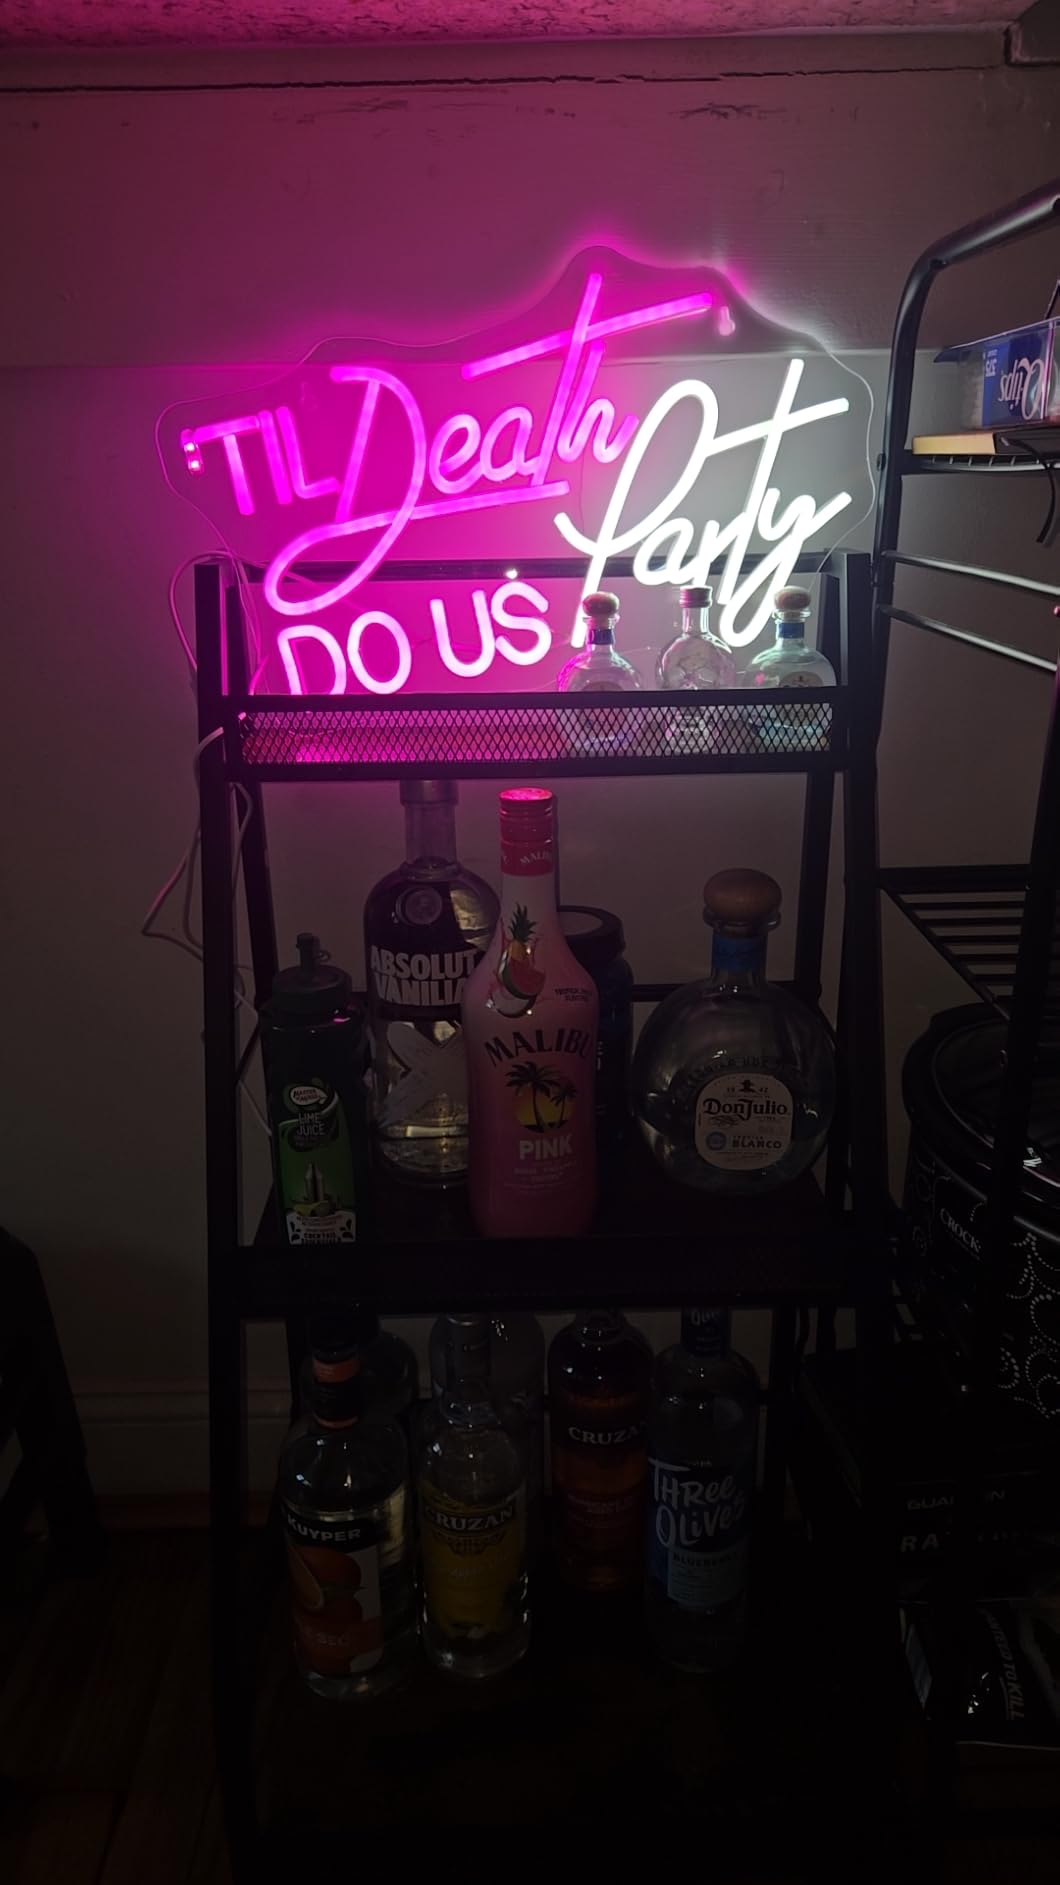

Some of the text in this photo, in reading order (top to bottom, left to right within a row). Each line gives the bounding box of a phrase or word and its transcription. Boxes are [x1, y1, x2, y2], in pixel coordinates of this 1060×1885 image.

[264, 273, 713, 616] Death
[554, 358, 852, 648] Party
[277, 582, 552, 695] DO US
[371, 945, 479, 981] ABSOLUT
[484, 1028, 591, 1068] MALIBU
[295, 1121, 326, 1136] JUICE
[297, 1112, 321, 1124] LIME
[519, 1133, 574, 1161] PINK
[732, 1138, 782, 1149] BLANCO
[568, 1418, 643, 1446] CRUZA
[287, 1512, 361, 1542] KUYPER
[424, 1504, 513, 1531] CRUZAN
